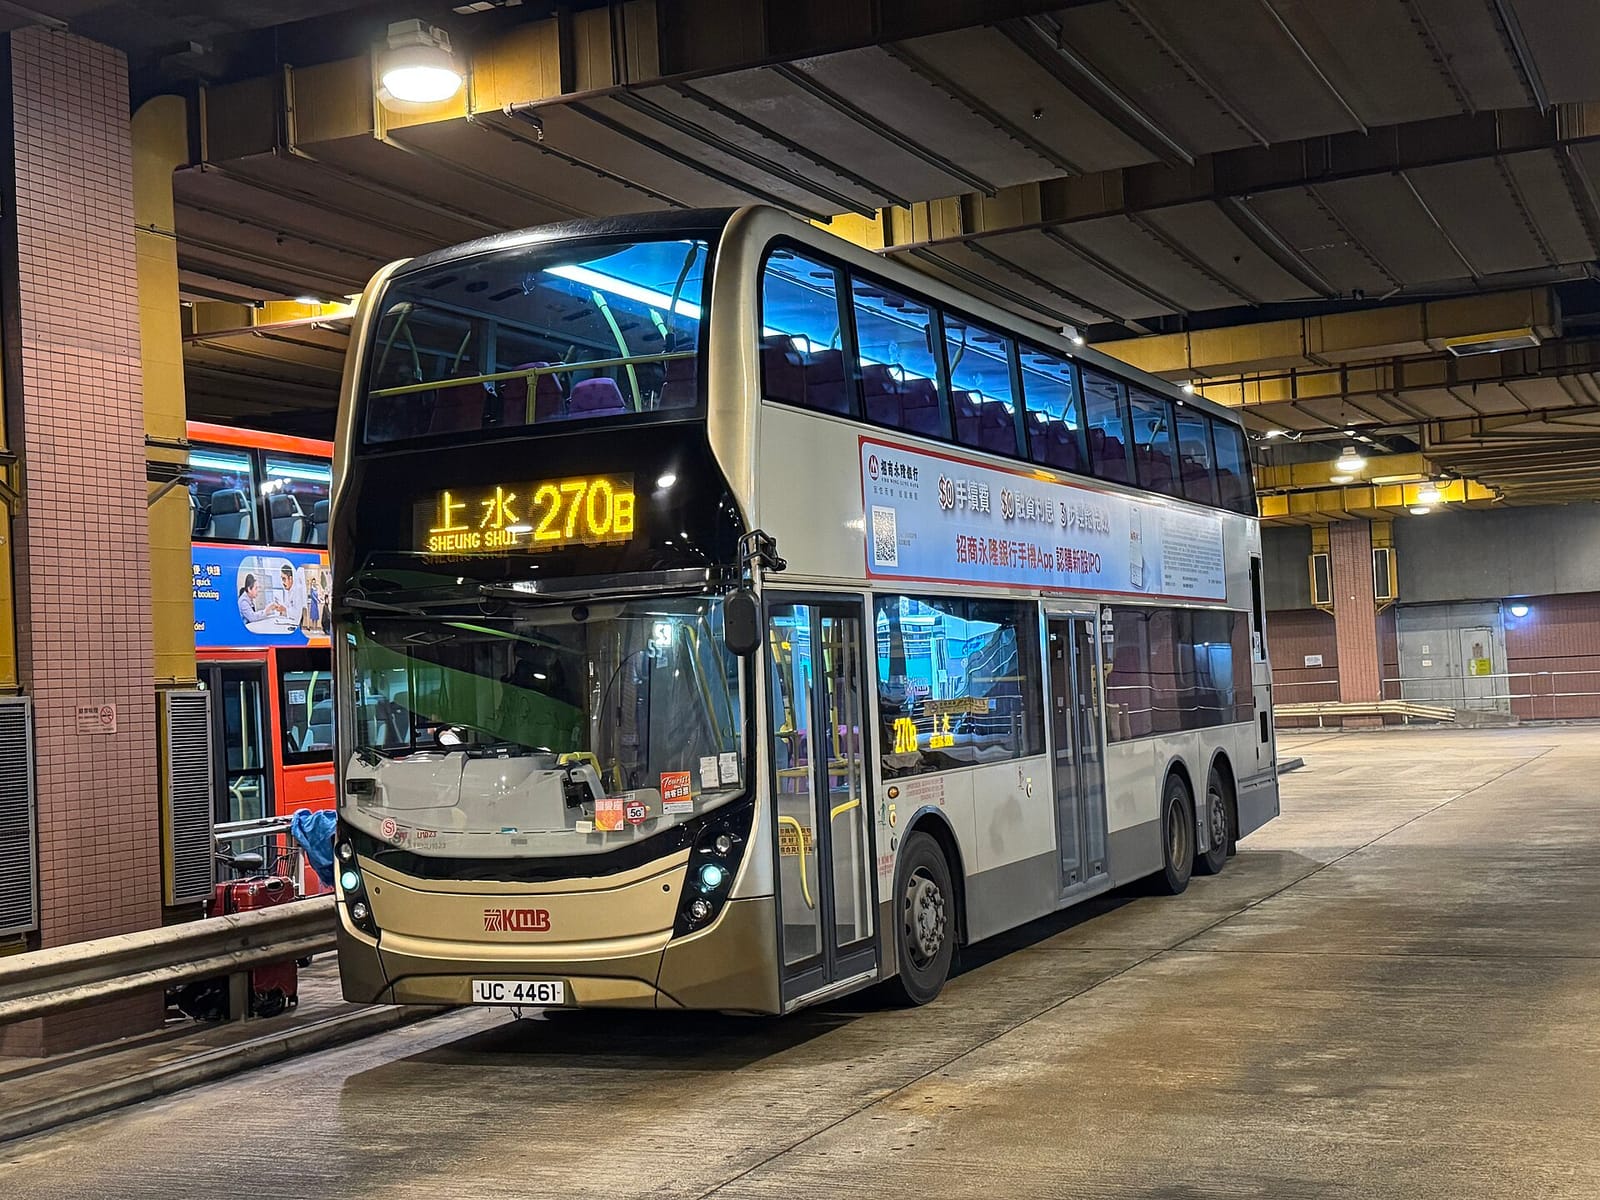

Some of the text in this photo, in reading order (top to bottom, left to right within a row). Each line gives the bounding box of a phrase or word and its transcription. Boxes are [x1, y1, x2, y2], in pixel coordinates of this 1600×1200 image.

[429, 486, 520, 533] 上水
[533, 480, 636, 541] 270B
[429, 530, 519, 552] SHEUNG SHUI
[502, 909, 551, 931] KMB
[480, 983, 556, 1001] UC 4461
